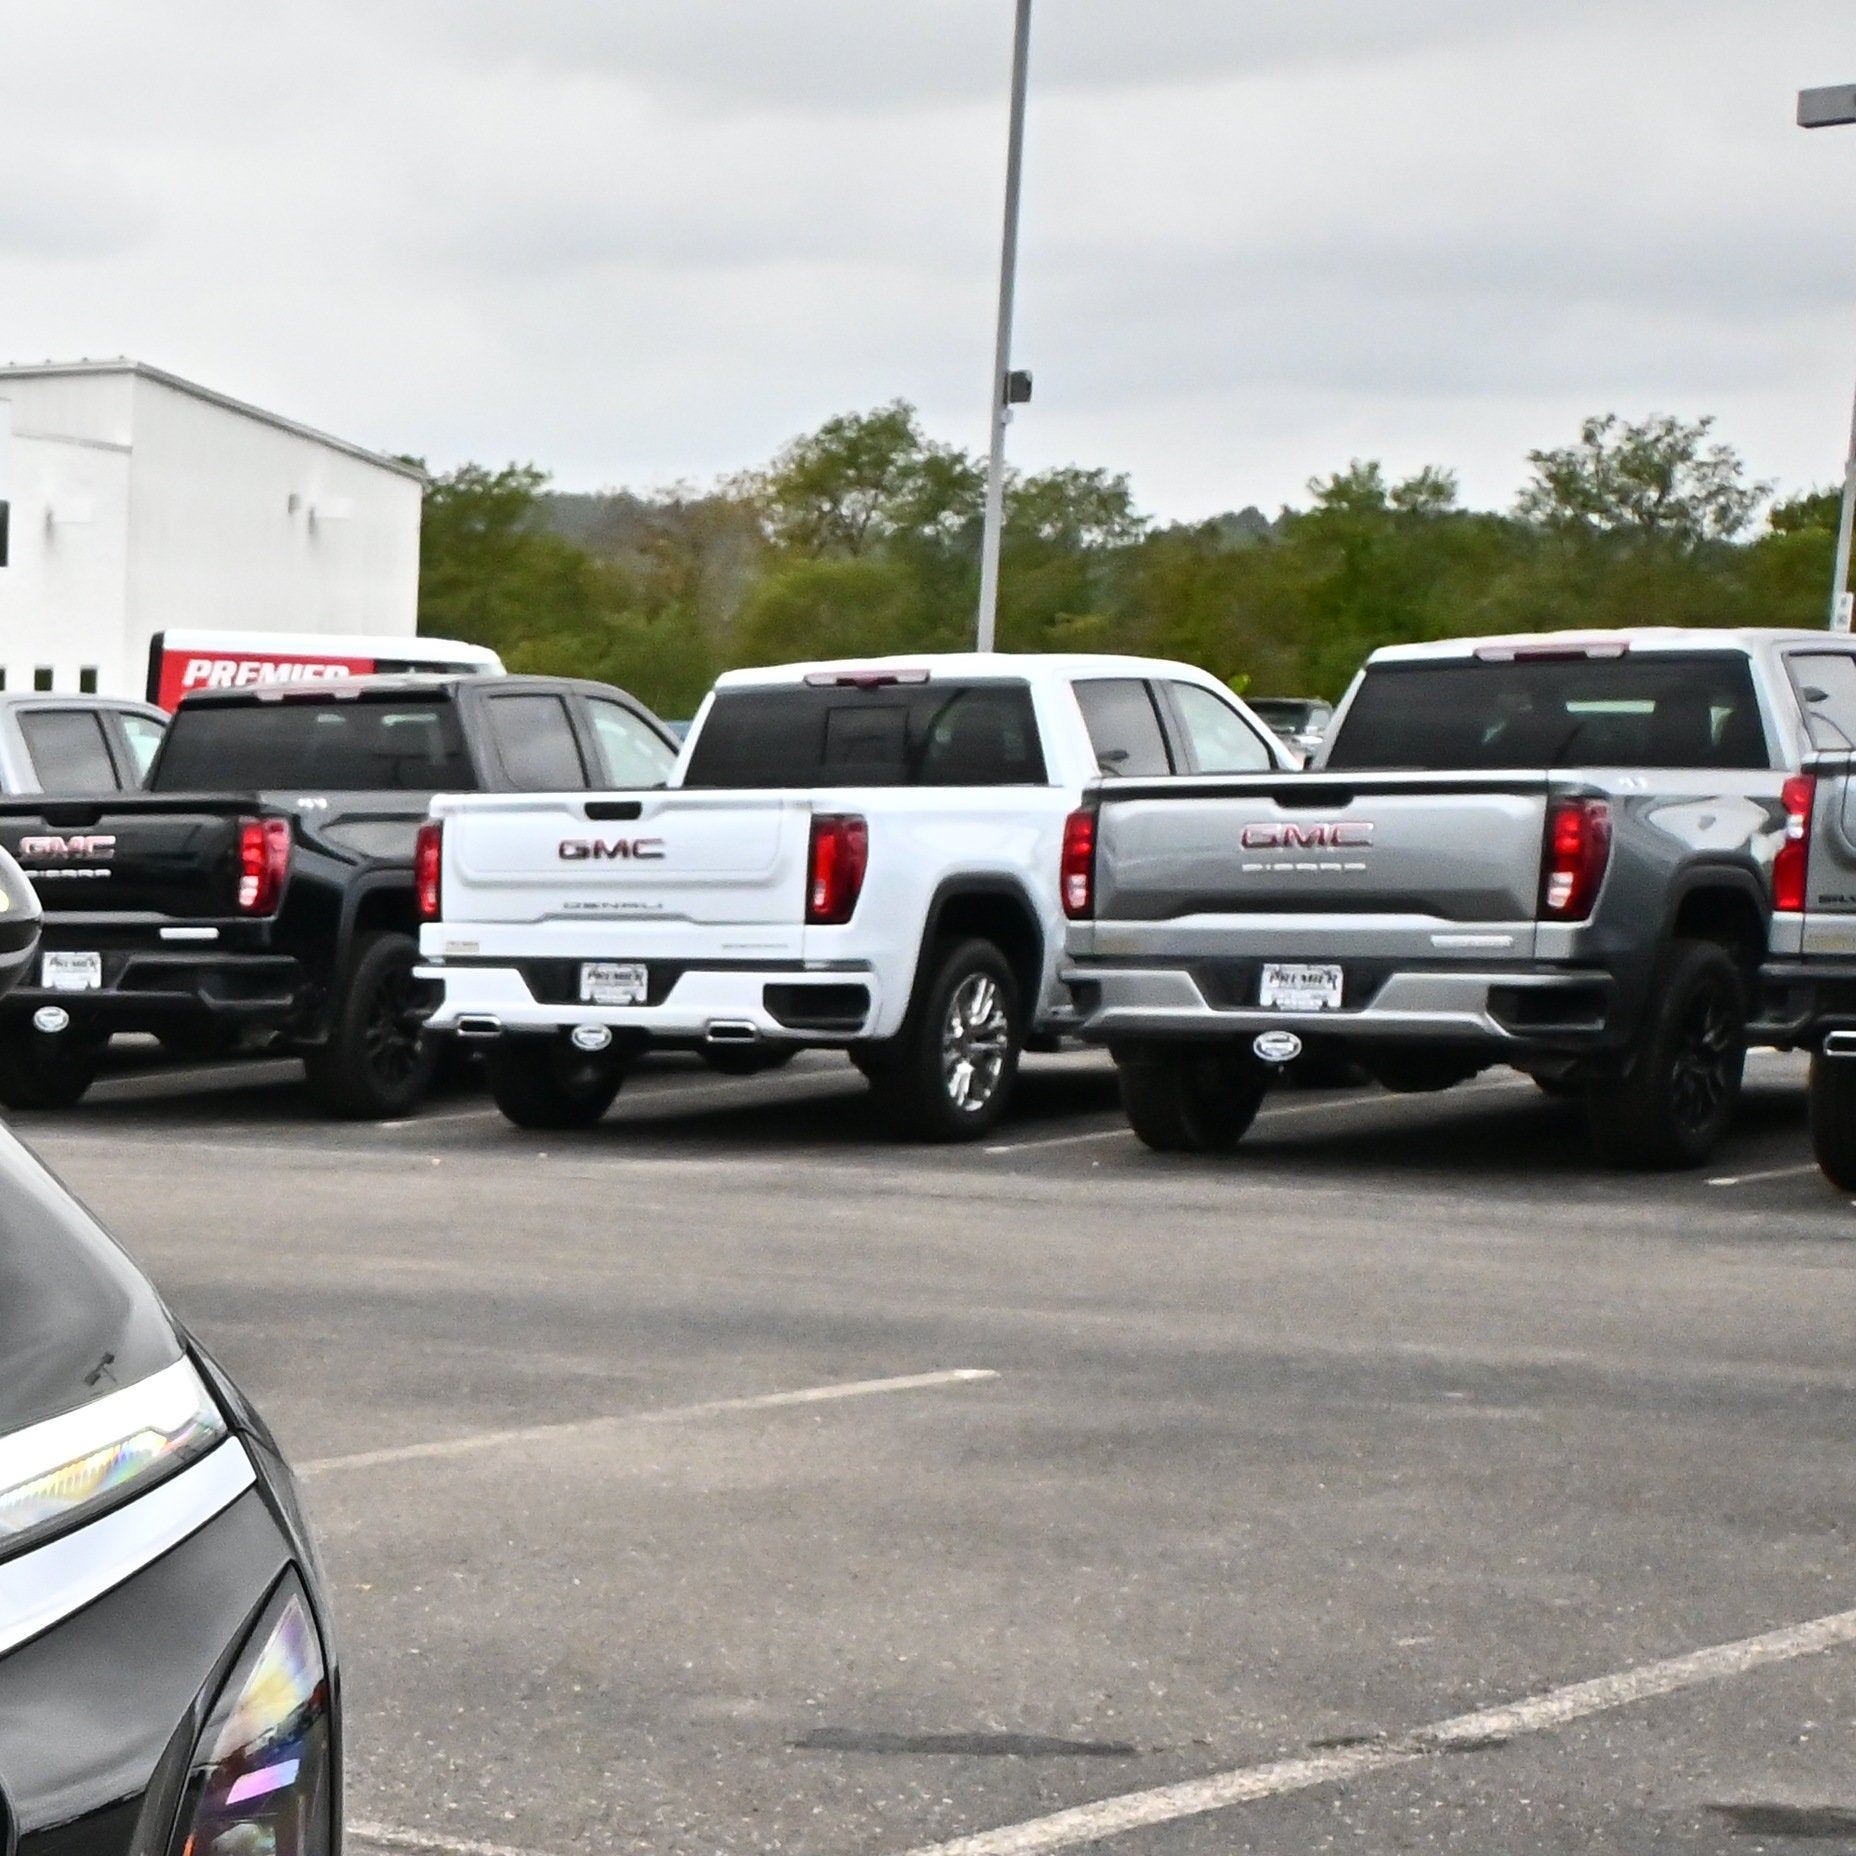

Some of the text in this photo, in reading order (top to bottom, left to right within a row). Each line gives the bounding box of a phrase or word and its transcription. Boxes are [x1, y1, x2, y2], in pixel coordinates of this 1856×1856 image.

[19, 835, 116, 858] GMC
[1241, 822, 1375, 850] GMC
[558, 838, 666, 860] GMC
